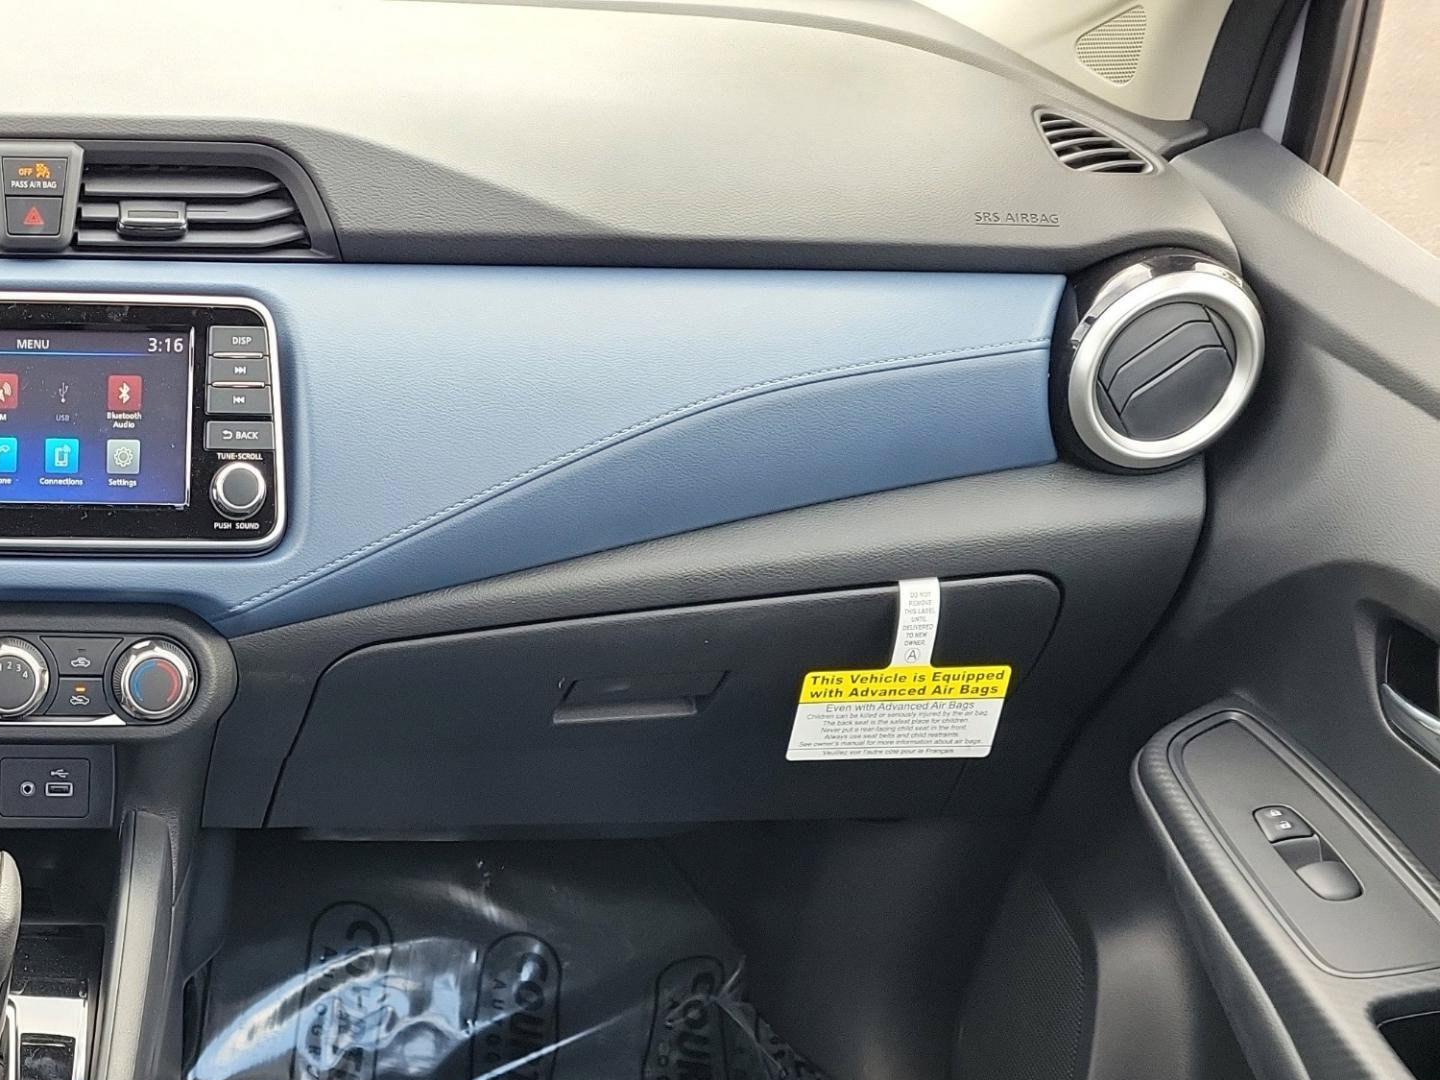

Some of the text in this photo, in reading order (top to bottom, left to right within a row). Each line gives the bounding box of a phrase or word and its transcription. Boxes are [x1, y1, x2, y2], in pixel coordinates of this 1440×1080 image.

[18, 168, 33, 176] OFF
[974, 212, 1059, 224] SRS AIRBAG
[16, 339, 50, 349] MENU
[148, 338, 183, 353] 3:16
[232, 336, 252, 345] DISP
[55, 414, 70, 422] USB
[107, 412, 142, 421] Bluetooth
[113, 421, 135, 429] Audio
[235, 431, 259, 440] BACK
[39, 477, 84, 487] Connections
[108, 478, 137, 488] Settings
[213, 522, 260, 530] PUSH SOUND
[907, 649, 917, 660] A
[811, 669, 1005, 686] This Vehicle is Equipped
[810, 684, 1000, 698] with Advanced Air Bags
[826, 700, 975, 713] Even with Advanced Air Bags
